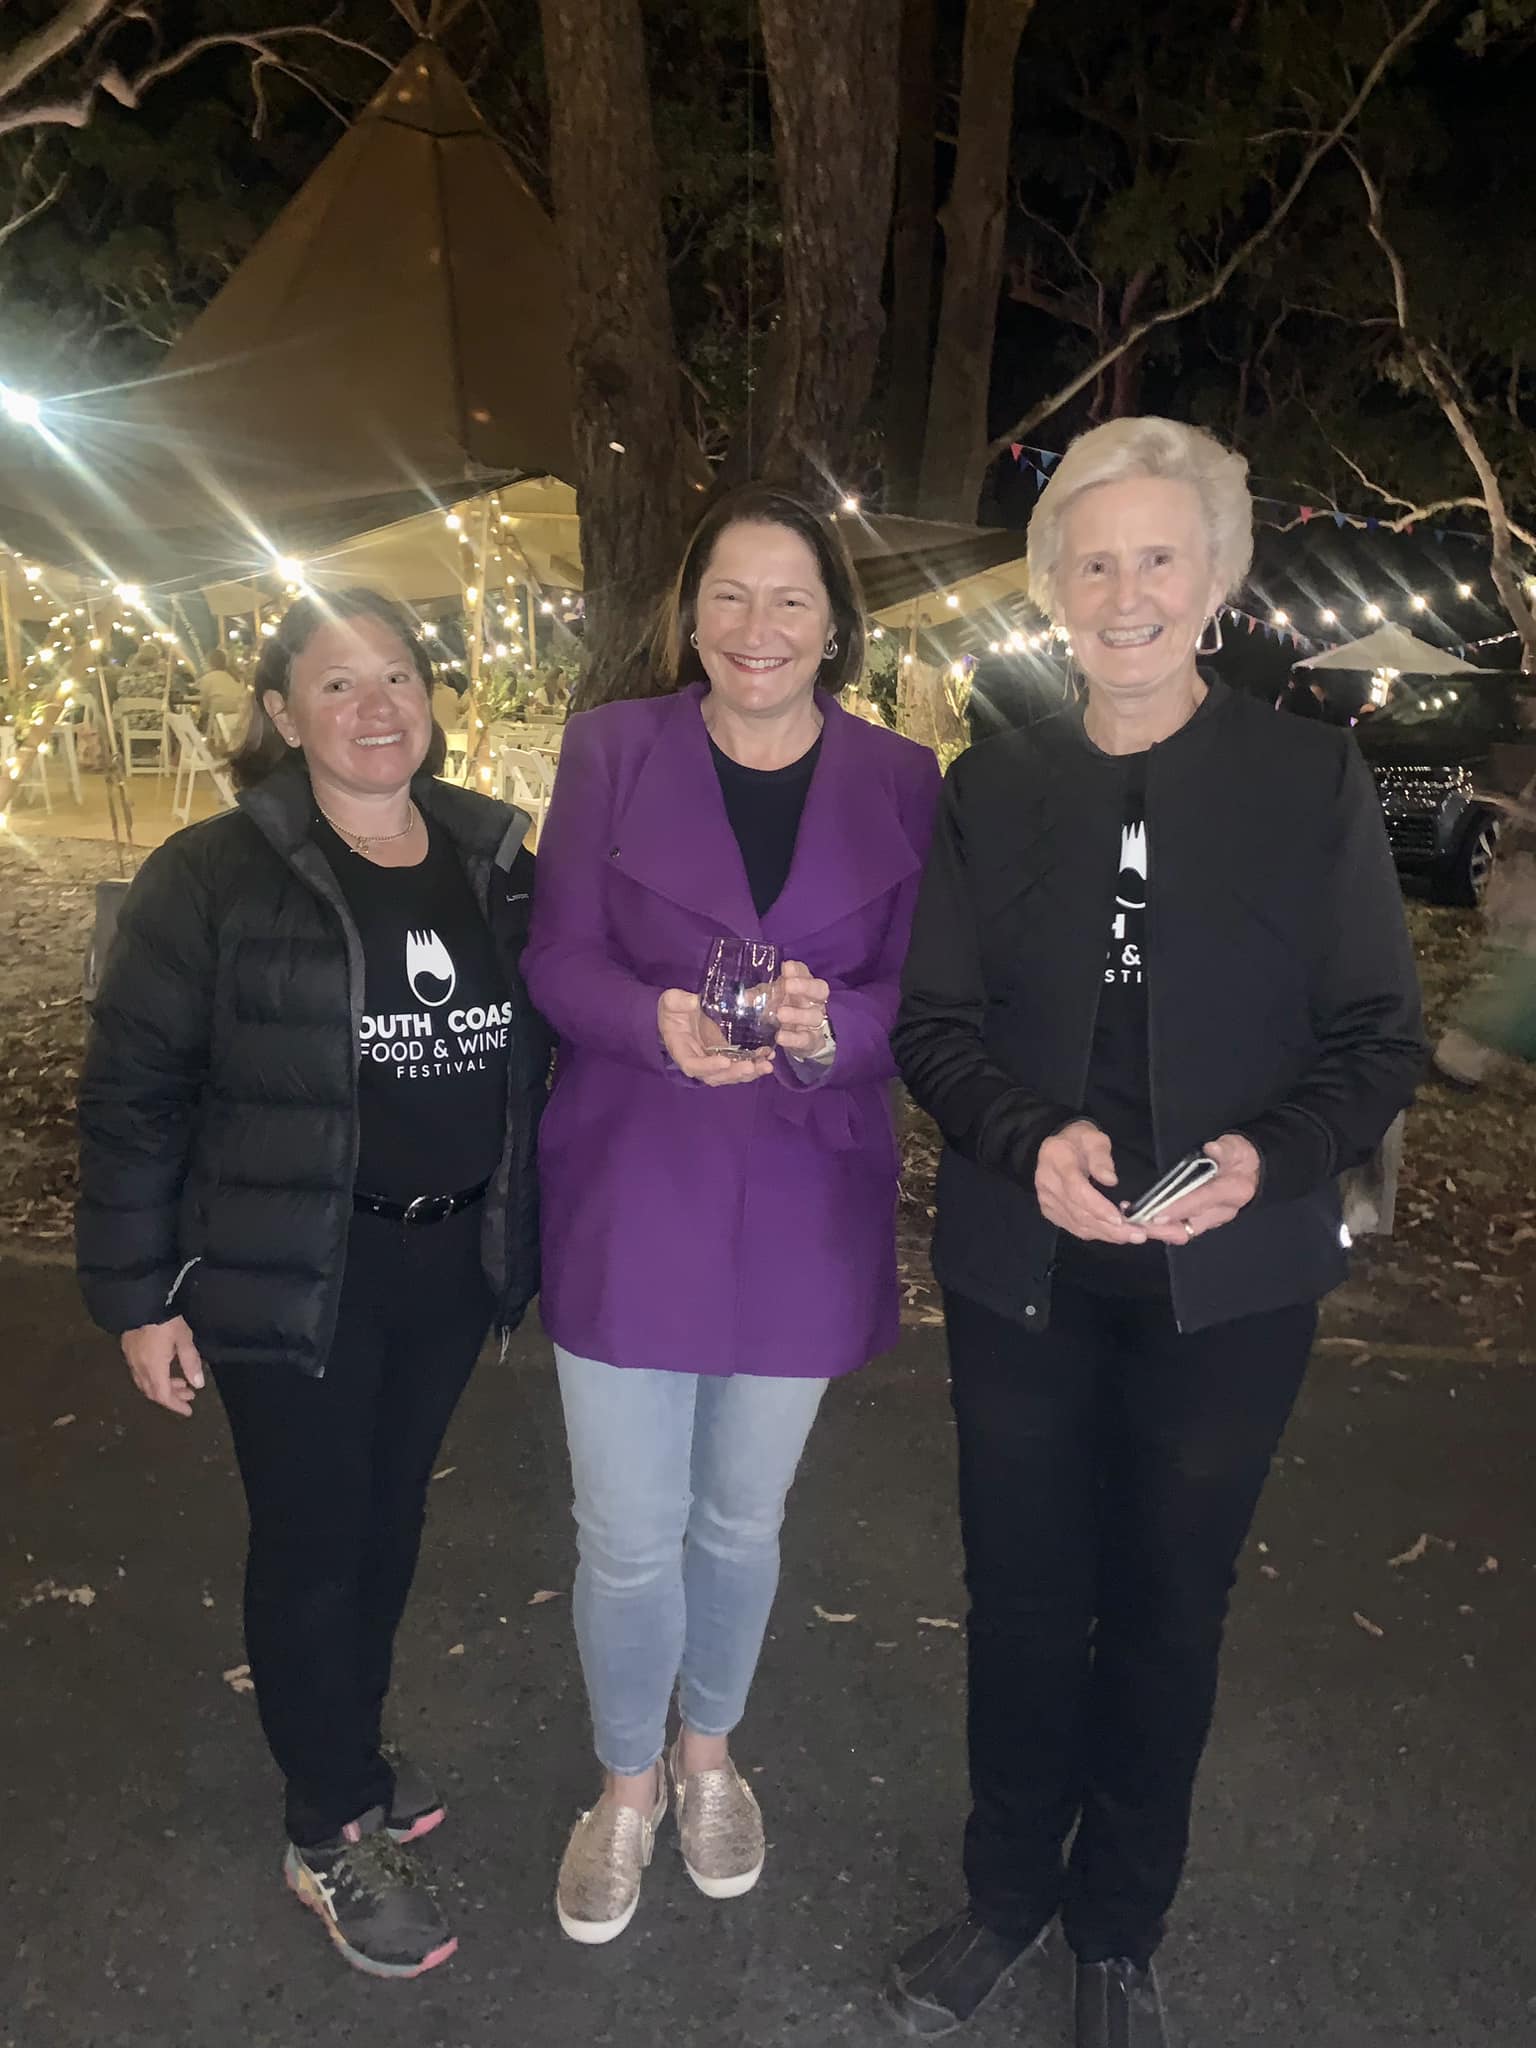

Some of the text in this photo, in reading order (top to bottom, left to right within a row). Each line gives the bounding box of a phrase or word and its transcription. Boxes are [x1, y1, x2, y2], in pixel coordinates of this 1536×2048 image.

[1121, 944, 1142, 966] &
[359, 1001, 512, 1039] OUTH COAS
[433, 1039, 449, 1059] &
[457, 1028, 508, 1055] WINE
[397, 1058, 486, 1079] FESTIVAL
